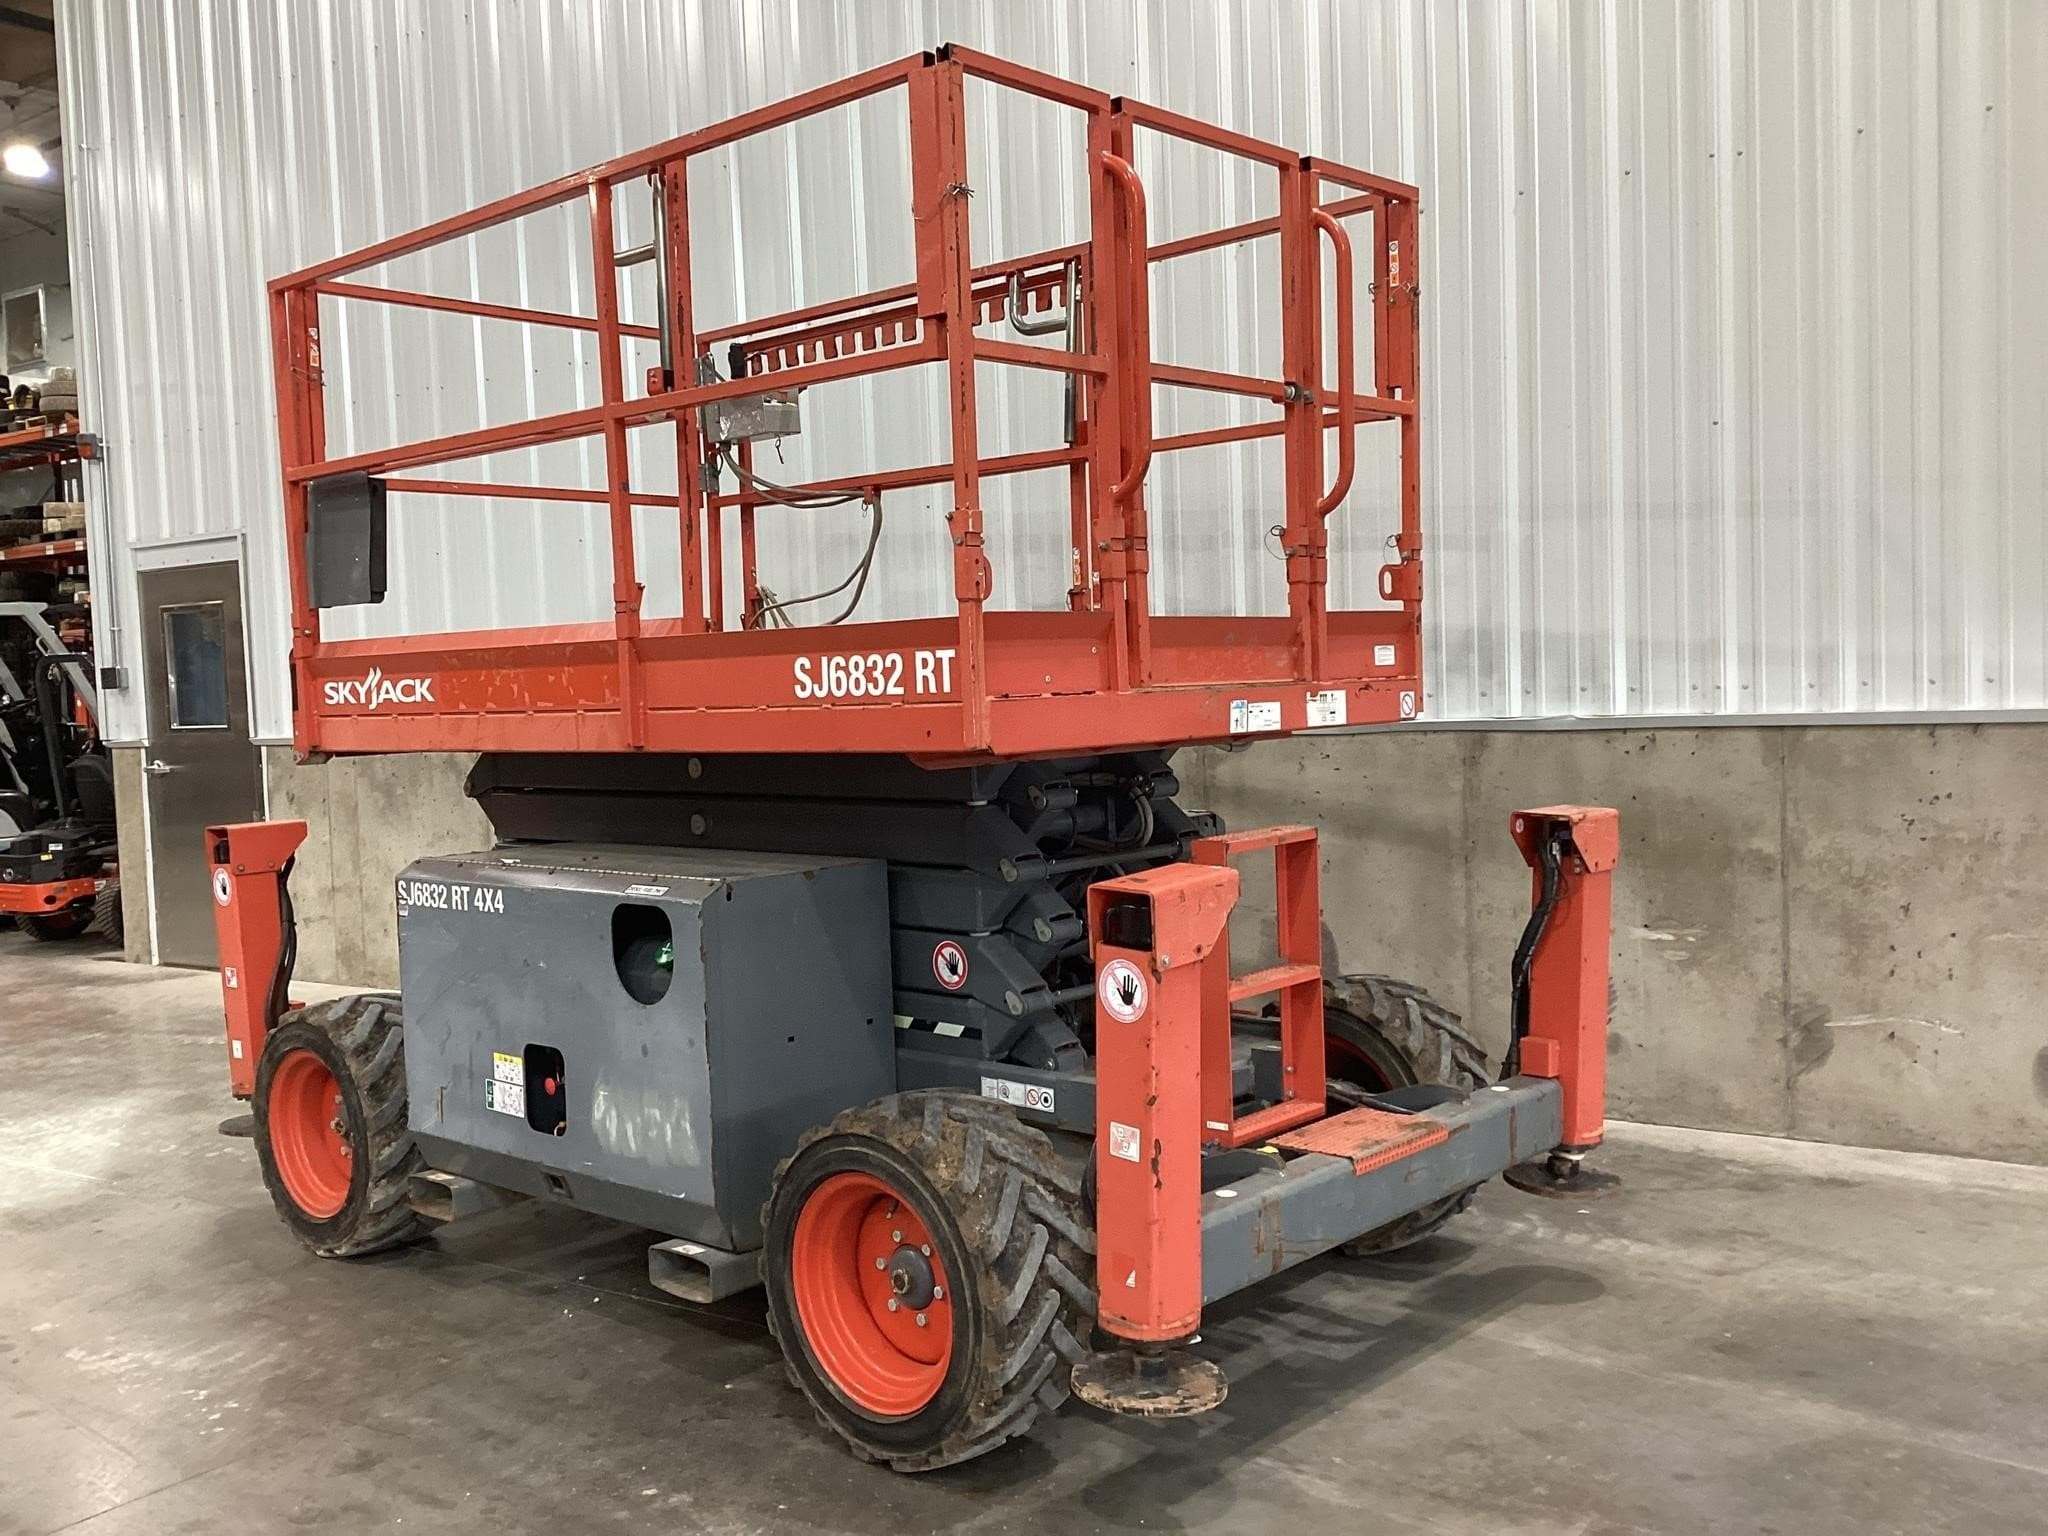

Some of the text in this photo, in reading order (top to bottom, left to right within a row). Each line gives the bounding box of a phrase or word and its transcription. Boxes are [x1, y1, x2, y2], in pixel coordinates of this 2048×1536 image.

[323, 666, 435, 710] SKYJACK
[794, 649, 956, 699] SJ6832 RT
[397, 880, 504, 914] SJ6832 RT 4X4
